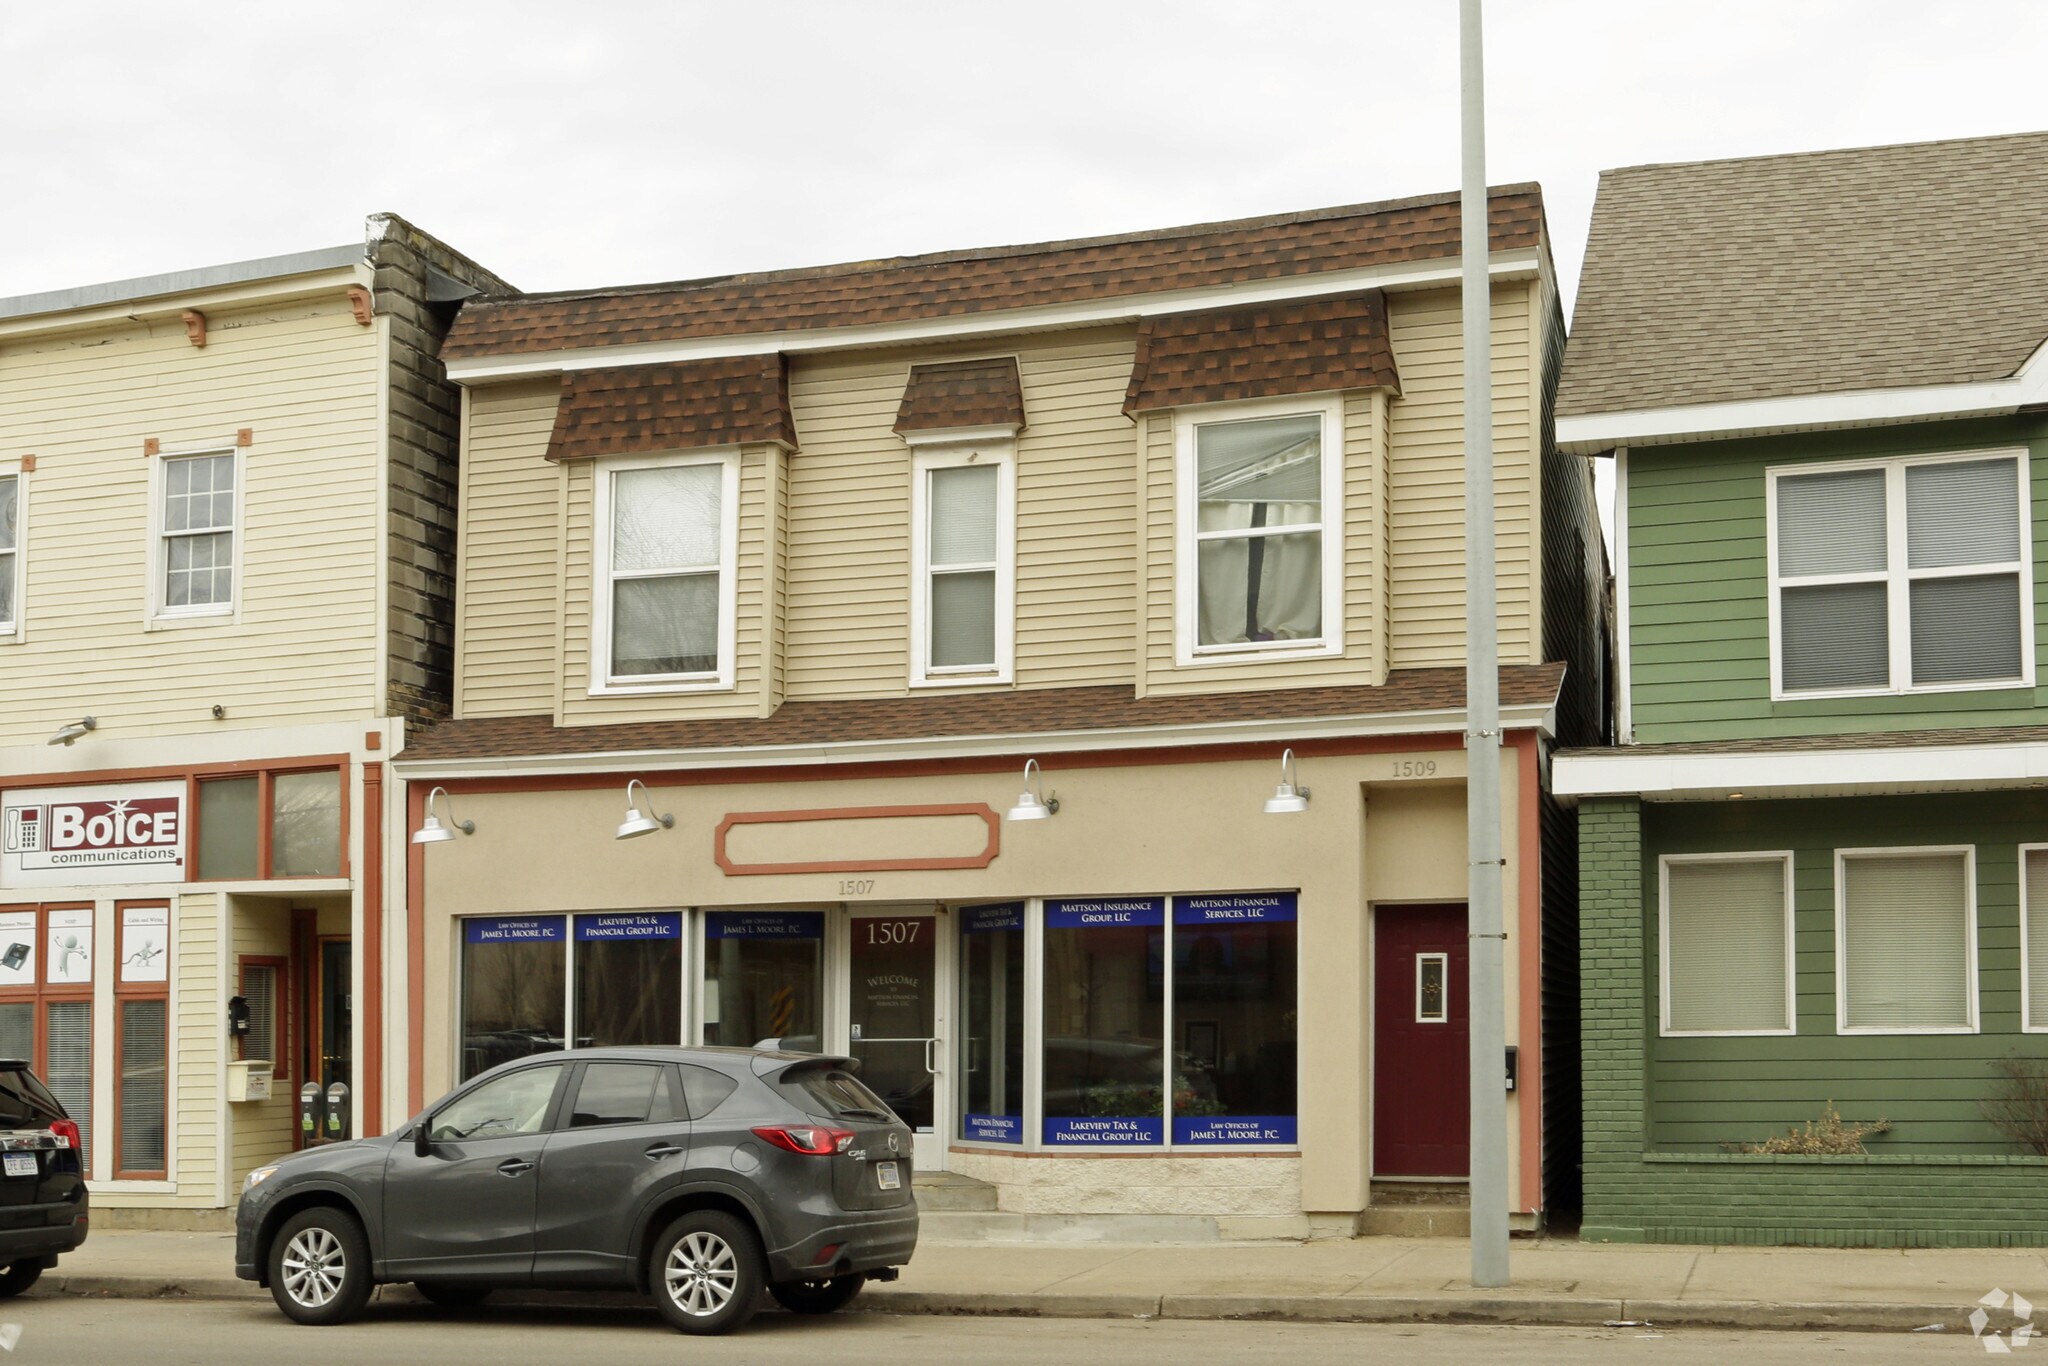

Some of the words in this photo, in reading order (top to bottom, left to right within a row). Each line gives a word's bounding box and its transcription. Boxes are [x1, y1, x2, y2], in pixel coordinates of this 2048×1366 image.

[1392, 760, 1436, 777] 1509
[51, 848, 176, 864] communications
[838, 880, 875, 896] 1507
[1061, 904, 1102, 912] MATTSON
[1104, 903, 1152, 911] INSURANCE
[1190, 900, 1231, 908] MATTSON
[1234, 898, 1279, 907] FINANCIAL
[1114, 913, 1131, 922] LLC
[1248, 908, 1264, 917] LLC
[598, 918, 634, 926] LAKEVIEW
[636, 916, 650, 924] TAX
[650, 916, 658, 924] &
[586, 928, 625, 936] FINANCIAL
[626, 926, 654, 935] GROUP
[655, 926, 670, 934] LLC
[723, 925, 746, 934] JAMES
[867, 922, 920, 944] 1507
[481, 930, 503, 940] JAMES
[867, 974, 919, 988] WELCOME
[1070, 1121, 1111, 1130] LAKEVIEW
[1112, 1121, 1128, 1130] TAX
[1130, 1121, 1138, 1130] &
[1056, 1132, 1100, 1140] FINANCIAL
[1102, 1132, 1133, 1141] GROUP
[1135, 1132, 1151, 1141] LLC
[1190, 1130, 1216, 1140] JAMES
[1264, 1130, 1280, 1139] P.C.
